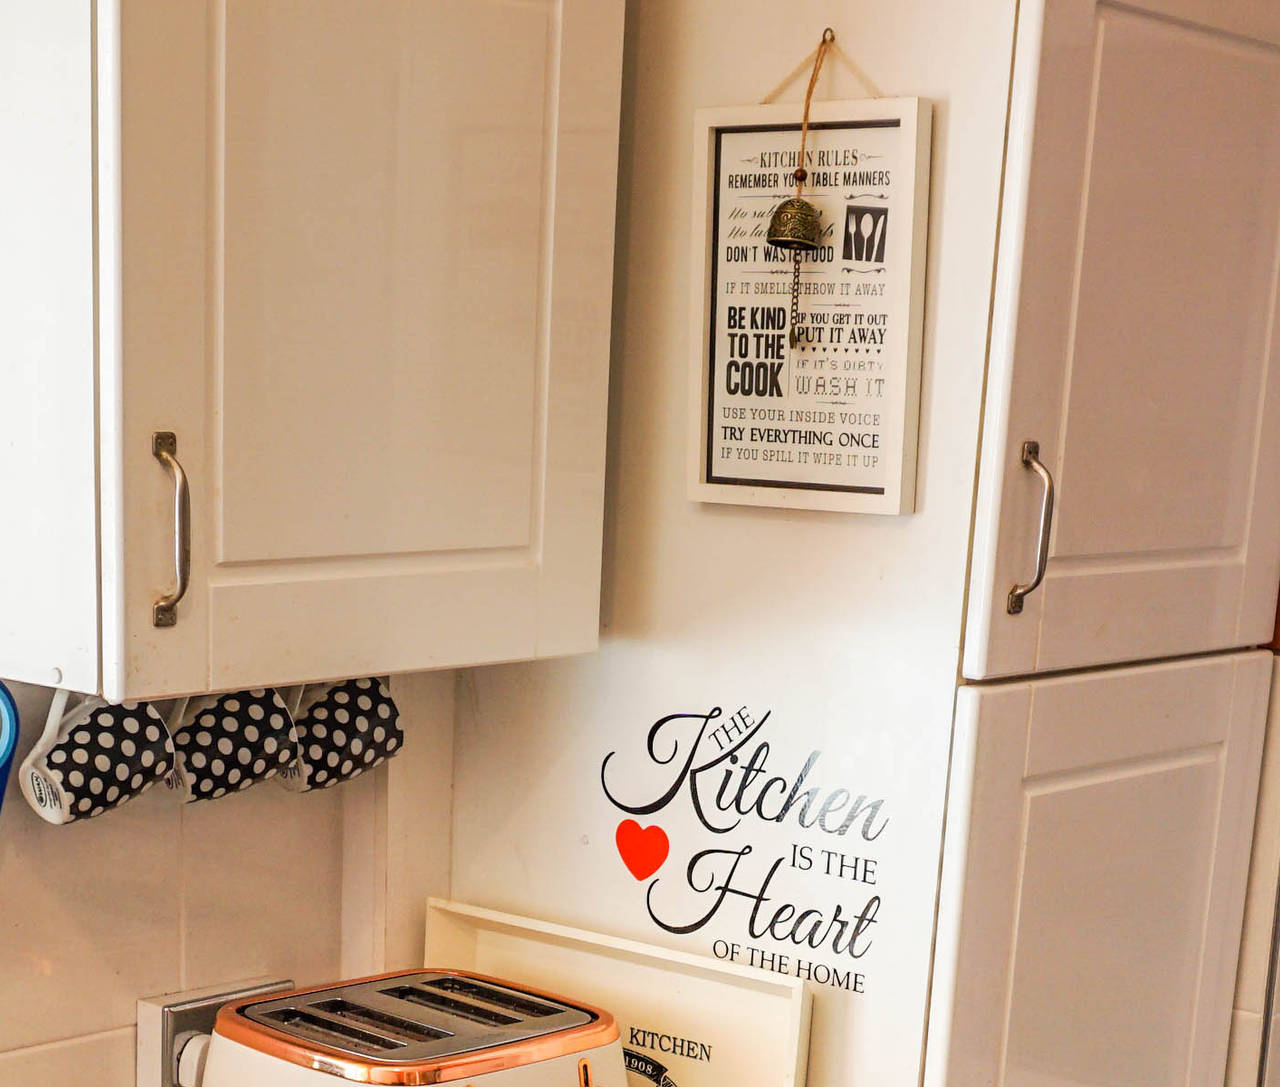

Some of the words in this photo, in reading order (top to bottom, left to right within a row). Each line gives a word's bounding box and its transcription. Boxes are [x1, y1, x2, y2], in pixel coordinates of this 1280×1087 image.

[760, 150, 813, 168] KITCHN
[818, 149, 859, 167] RULES
[728, 173, 779, 189] REMEMBER
[811, 172, 840, 187] TABLE
[843, 170, 891, 187] MANNERS
[726, 246, 758, 262] DON'T
[763, 245, 802, 262] WAST
[726, 282, 736, 295] IF
[740, 282, 750, 295] IT
[754, 282, 794, 295] SMELLS
[798, 282, 836, 295] THROW
[840, 283, 849, 296] IT
[855, 283, 886, 296] AWAY
[727, 306, 746, 330] BE
[750, 306, 786, 330] KIND
[797, 312, 807, 324] IF
[810, 313, 830, 324] YOU
[832, 313, 851, 325] GET
[854, 313, 865, 325] IT
[867, 314, 888, 326] OUT
[728, 333, 748, 359] TO
[753, 333, 785, 360] THE
[797, 327, 824, 343] PUT
[830, 328, 843, 344] IT
[848, 328, 887, 345] AWAY
[796, 359, 809, 369] IF
[813, 358, 838, 370] IT'S
[843, 359, 884, 371] DIRTY
[726, 360, 783, 398] COOK
[795, 376, 858, 397] WASH
[866, 378, 885, 398] IT
[723, 407, 746, 420] USE
[750, 408, 785, 421] YOUR
[789, 410, 836, 424] INSIDE
[840, 412, 880, 426] VOICE
[721, 426, 744, 441] TRY
[750, 427, 833, 446] EVERYTHING
[838, 432, 879, 449] ONCE
[721, 447, 732, 459] IF
[736, 448, 758, 461] YOU
[762, 449, 794, 463] SPILL
[798, 452, 809, 464] IT
[813, 452, 842, 466] WIPE
[847, 454, 858, 467] IT
[863, 455, 879, 468] UP
[708, 706, 756, 751] THE
[601, 706, 889, 842] Kitchen
[790, 844, 813, 870] IS
[821, 850, 878, 885] THE
[647, 845, 881, 959] Heart
[712, 939, 742, 961] OF
[747, 947, 789, 975] THE
[795, 960, 866, 994] HOME
[628, 1027, 713, 1063] KITCHEN
[625, 1056, 653, 1075] 1908
